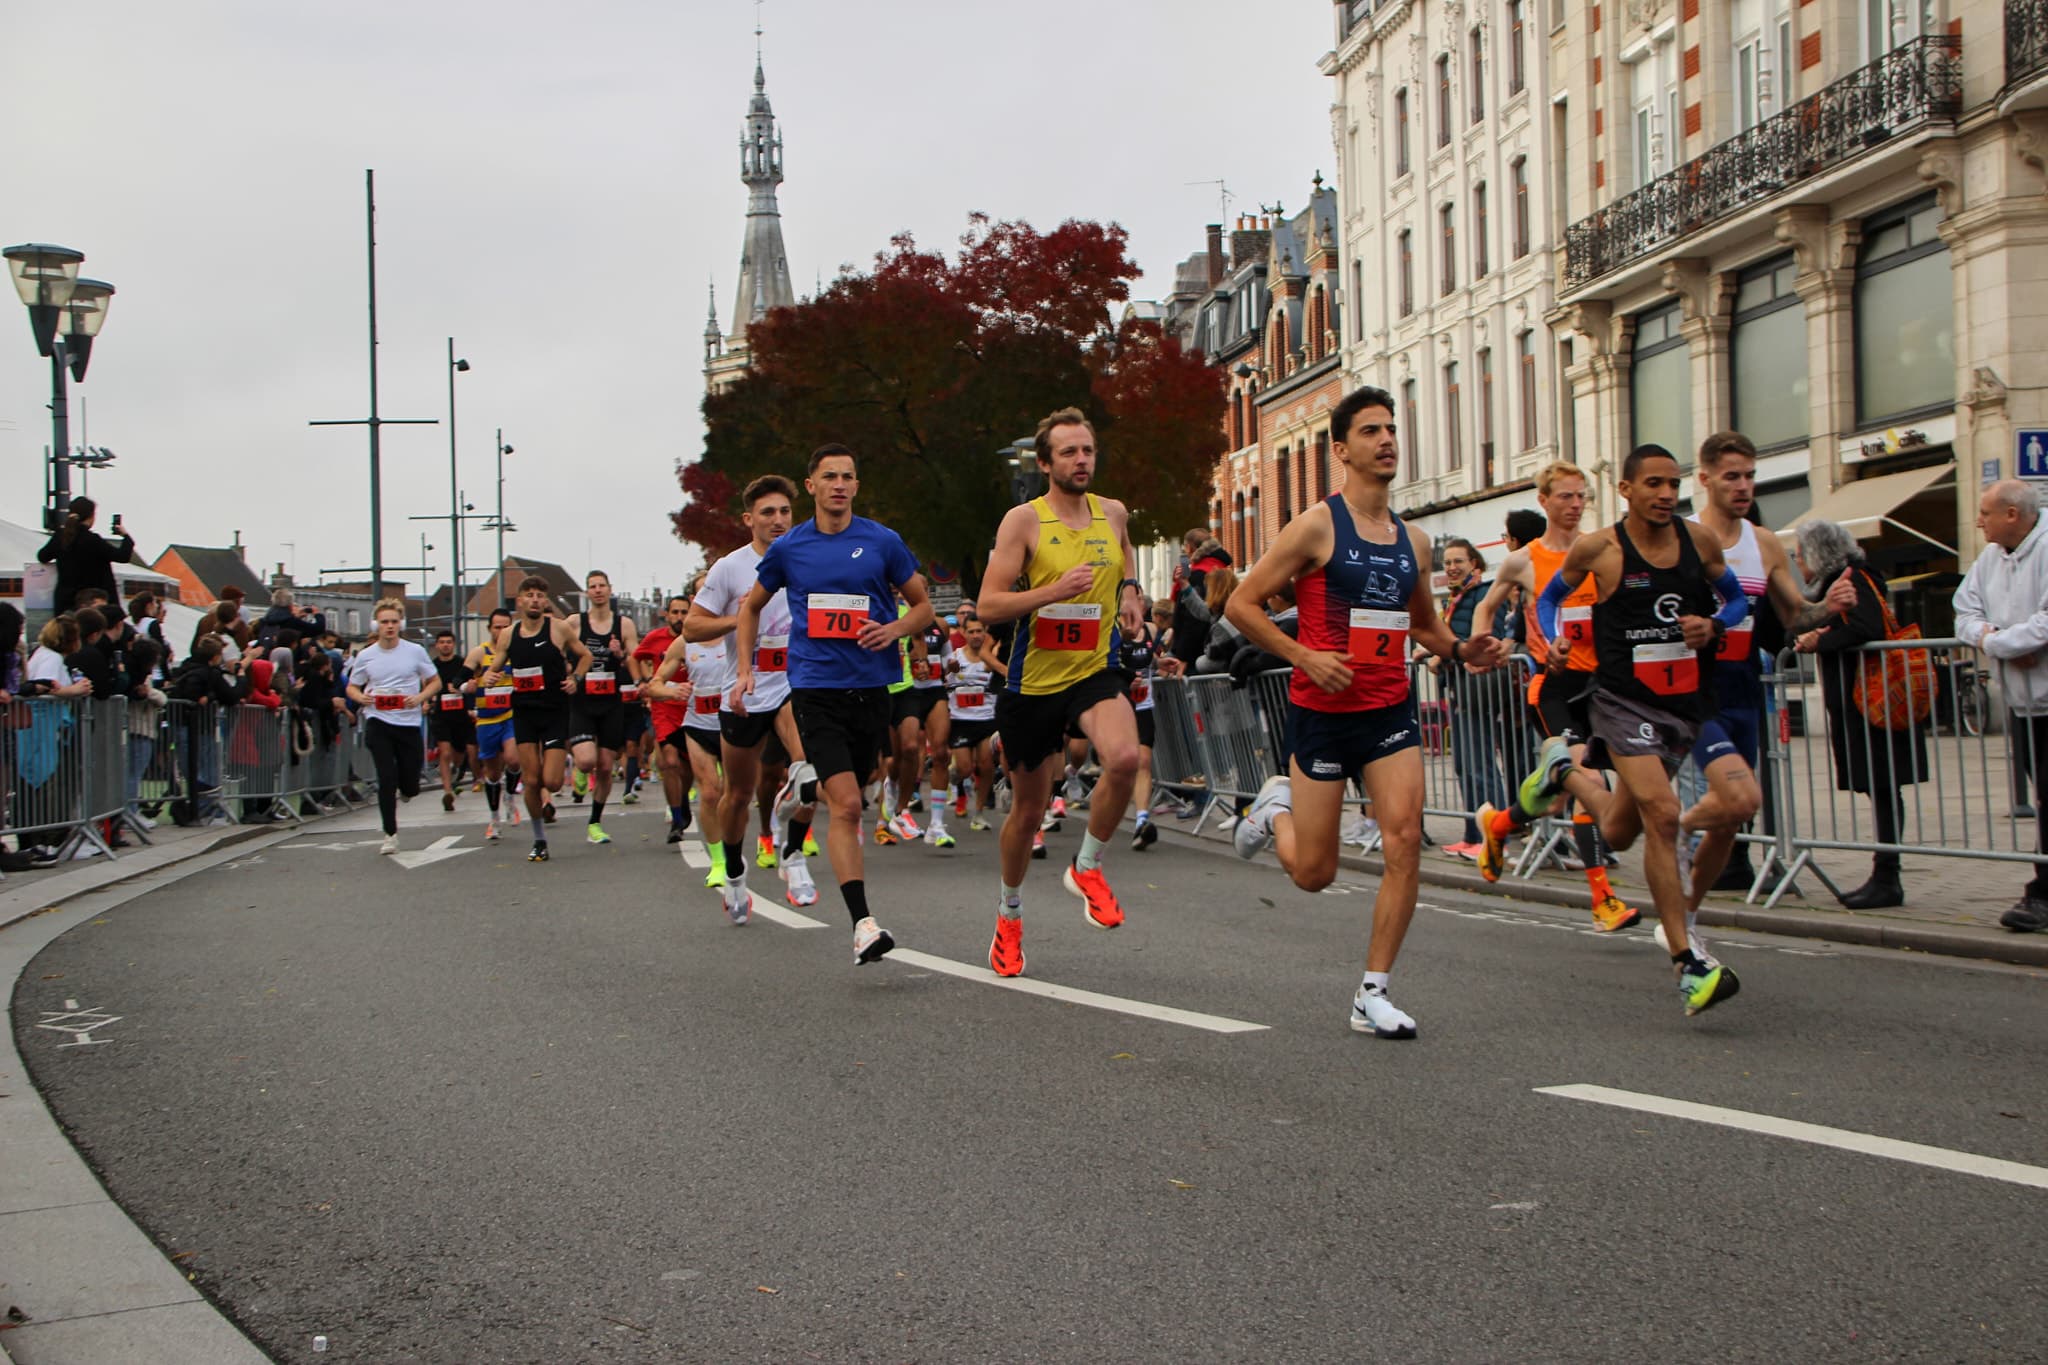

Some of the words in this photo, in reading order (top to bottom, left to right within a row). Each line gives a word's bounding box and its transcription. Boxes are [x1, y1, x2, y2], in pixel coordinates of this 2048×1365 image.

[825, 612, 851, 632] 70
[1571, 623, 1583, 640] 3
[1055, 623, 1082, 643] 15
[1625, 626, 1668, 640] running
[1375, 633, 1391, 657] 2
[773, 651, 787, 667] 6
[1663, 665, 1674, 687] 1
